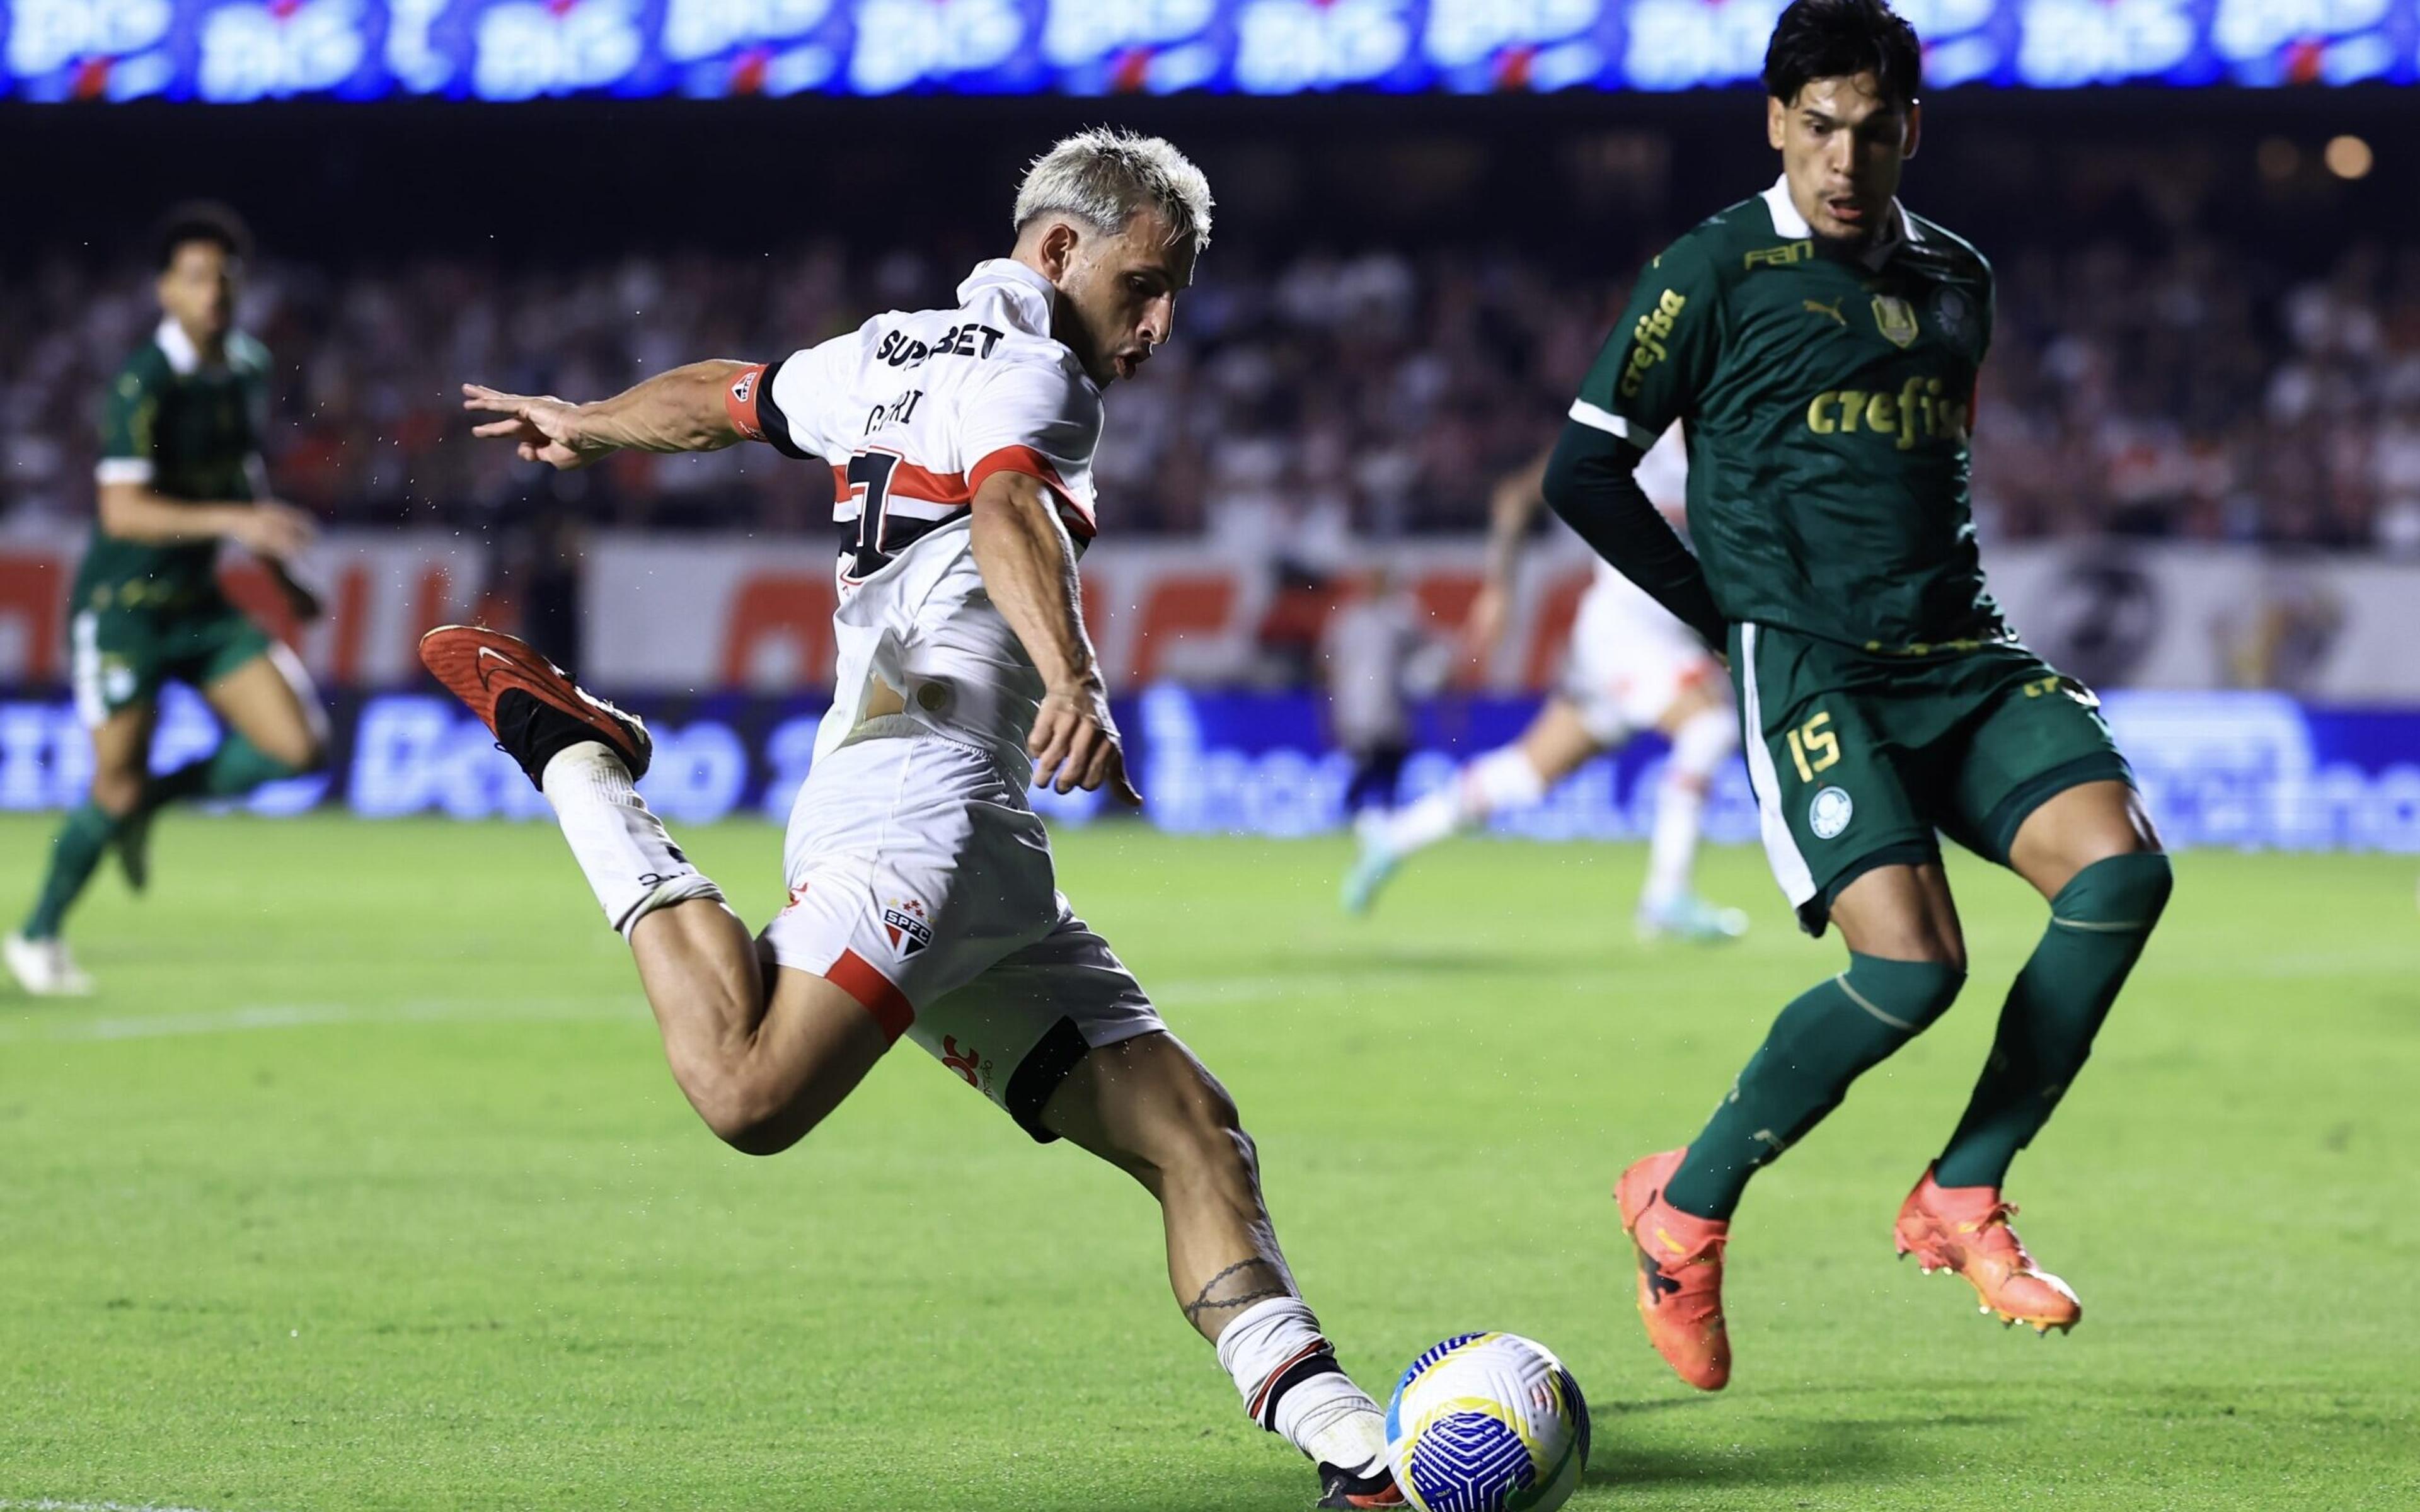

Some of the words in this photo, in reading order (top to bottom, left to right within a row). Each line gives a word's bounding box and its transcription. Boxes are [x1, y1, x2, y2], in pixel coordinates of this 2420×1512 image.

[1621, 288, 1686, 398] crefisa
[1787, 711, 1841, 783] 15
[886, 911, 930, 941] SPFC
